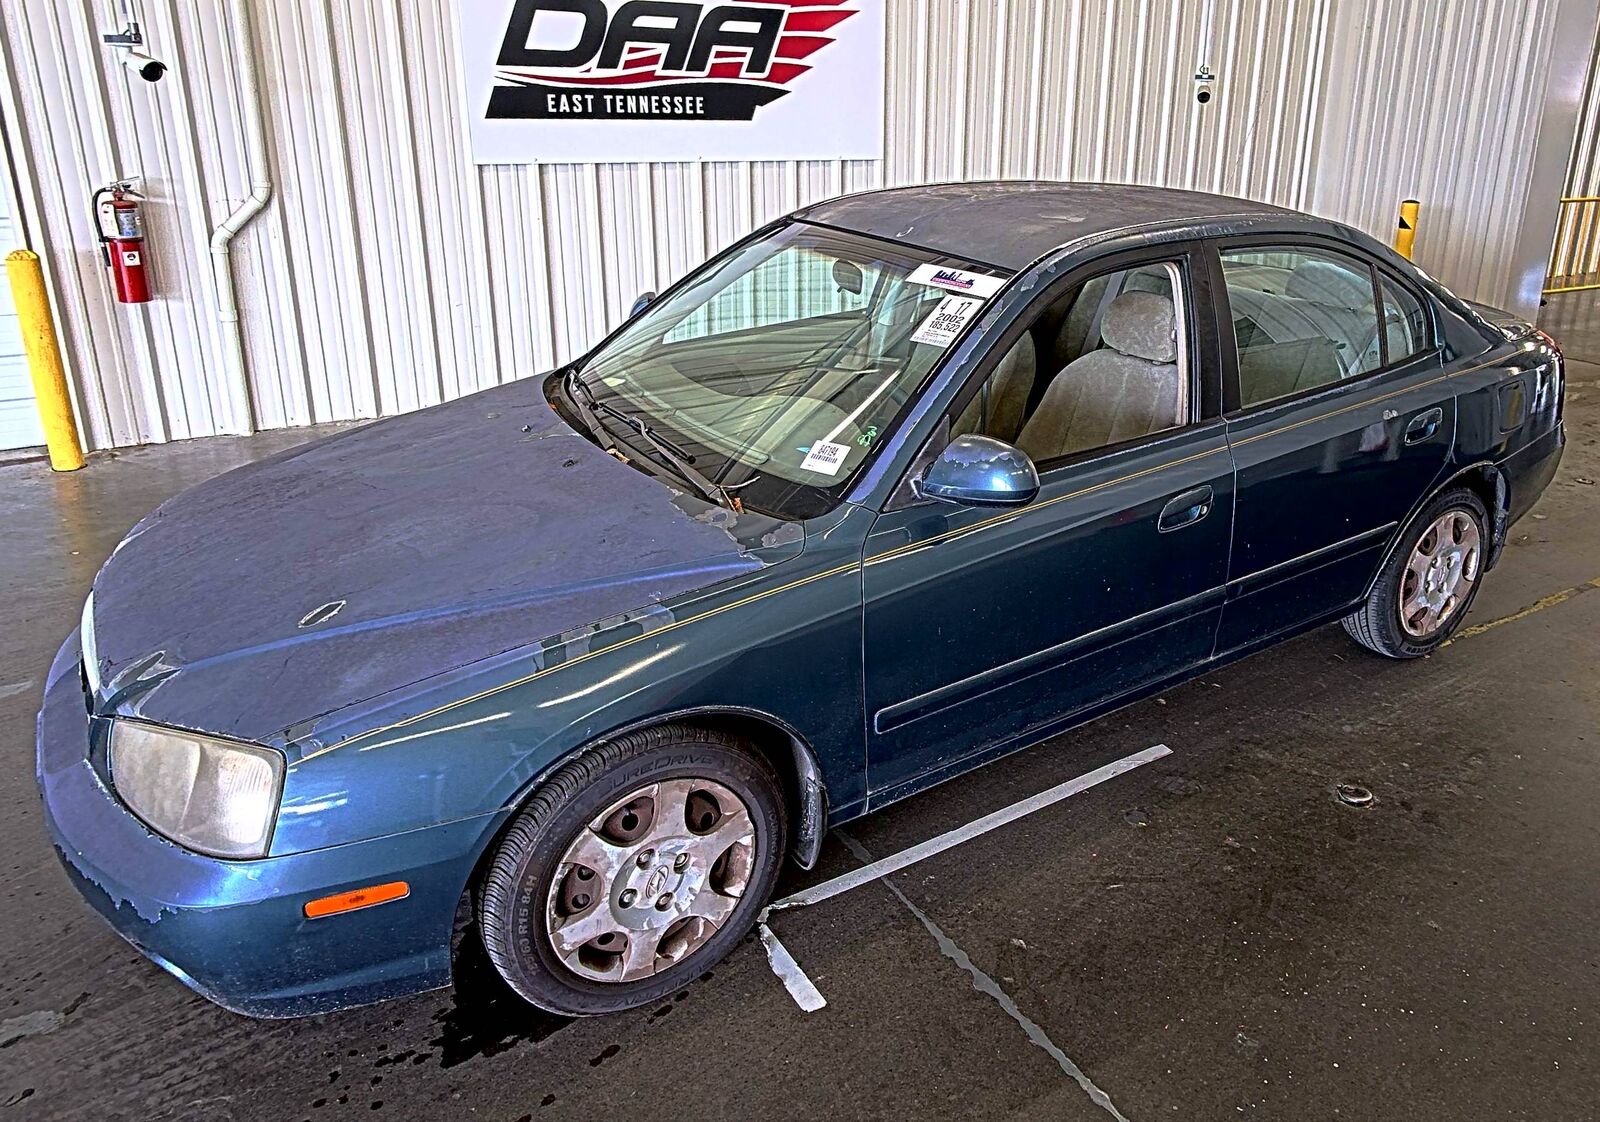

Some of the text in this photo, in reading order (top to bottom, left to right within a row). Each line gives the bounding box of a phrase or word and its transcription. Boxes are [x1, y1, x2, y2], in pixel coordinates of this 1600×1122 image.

[496, 0, 785, 76] DAA
[547, 94, 705, 116] EAST TENNESSEE
[940, 298, 973, 316] 4 17
[935, 312, 965, 325] 2002
[521, 875, 538, 905] 84H
